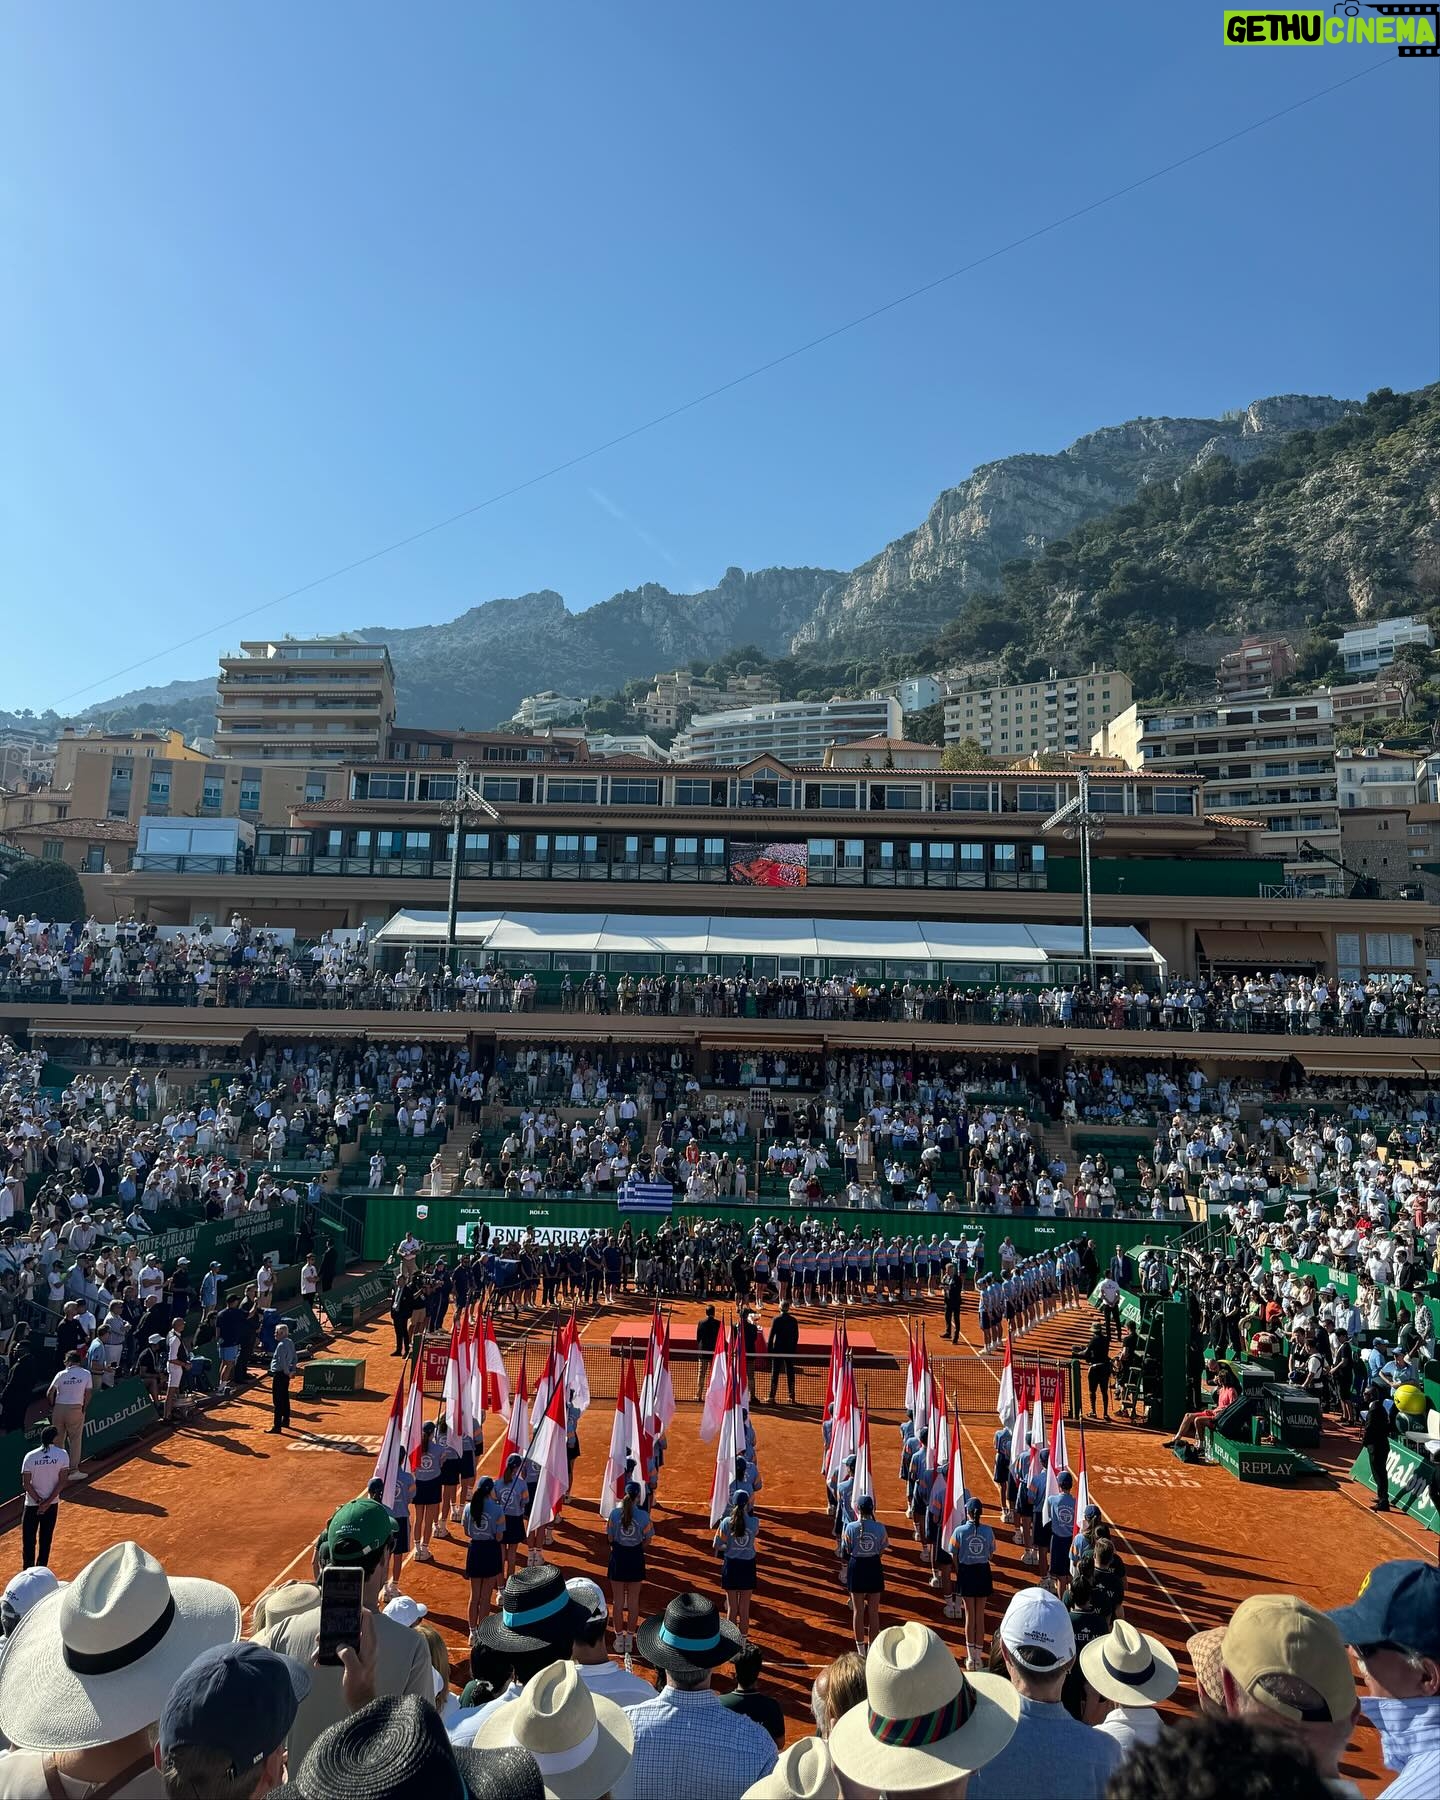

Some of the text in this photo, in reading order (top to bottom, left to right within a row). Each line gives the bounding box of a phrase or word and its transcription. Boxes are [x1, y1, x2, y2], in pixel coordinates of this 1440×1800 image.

[186, 1227, 200, 1242] BAY
[533, 1230, 592, 1245] PARIBA
[168, 1241, 196, 1260] RESORT
[84, 1396, 150, 1438] Maserati
[1286, 1415, 1319, 1426] VALMORA
[1241, 1461, 1293, 1476] REPLAY
[1101, 1475, 1201, 1488] CARLO
